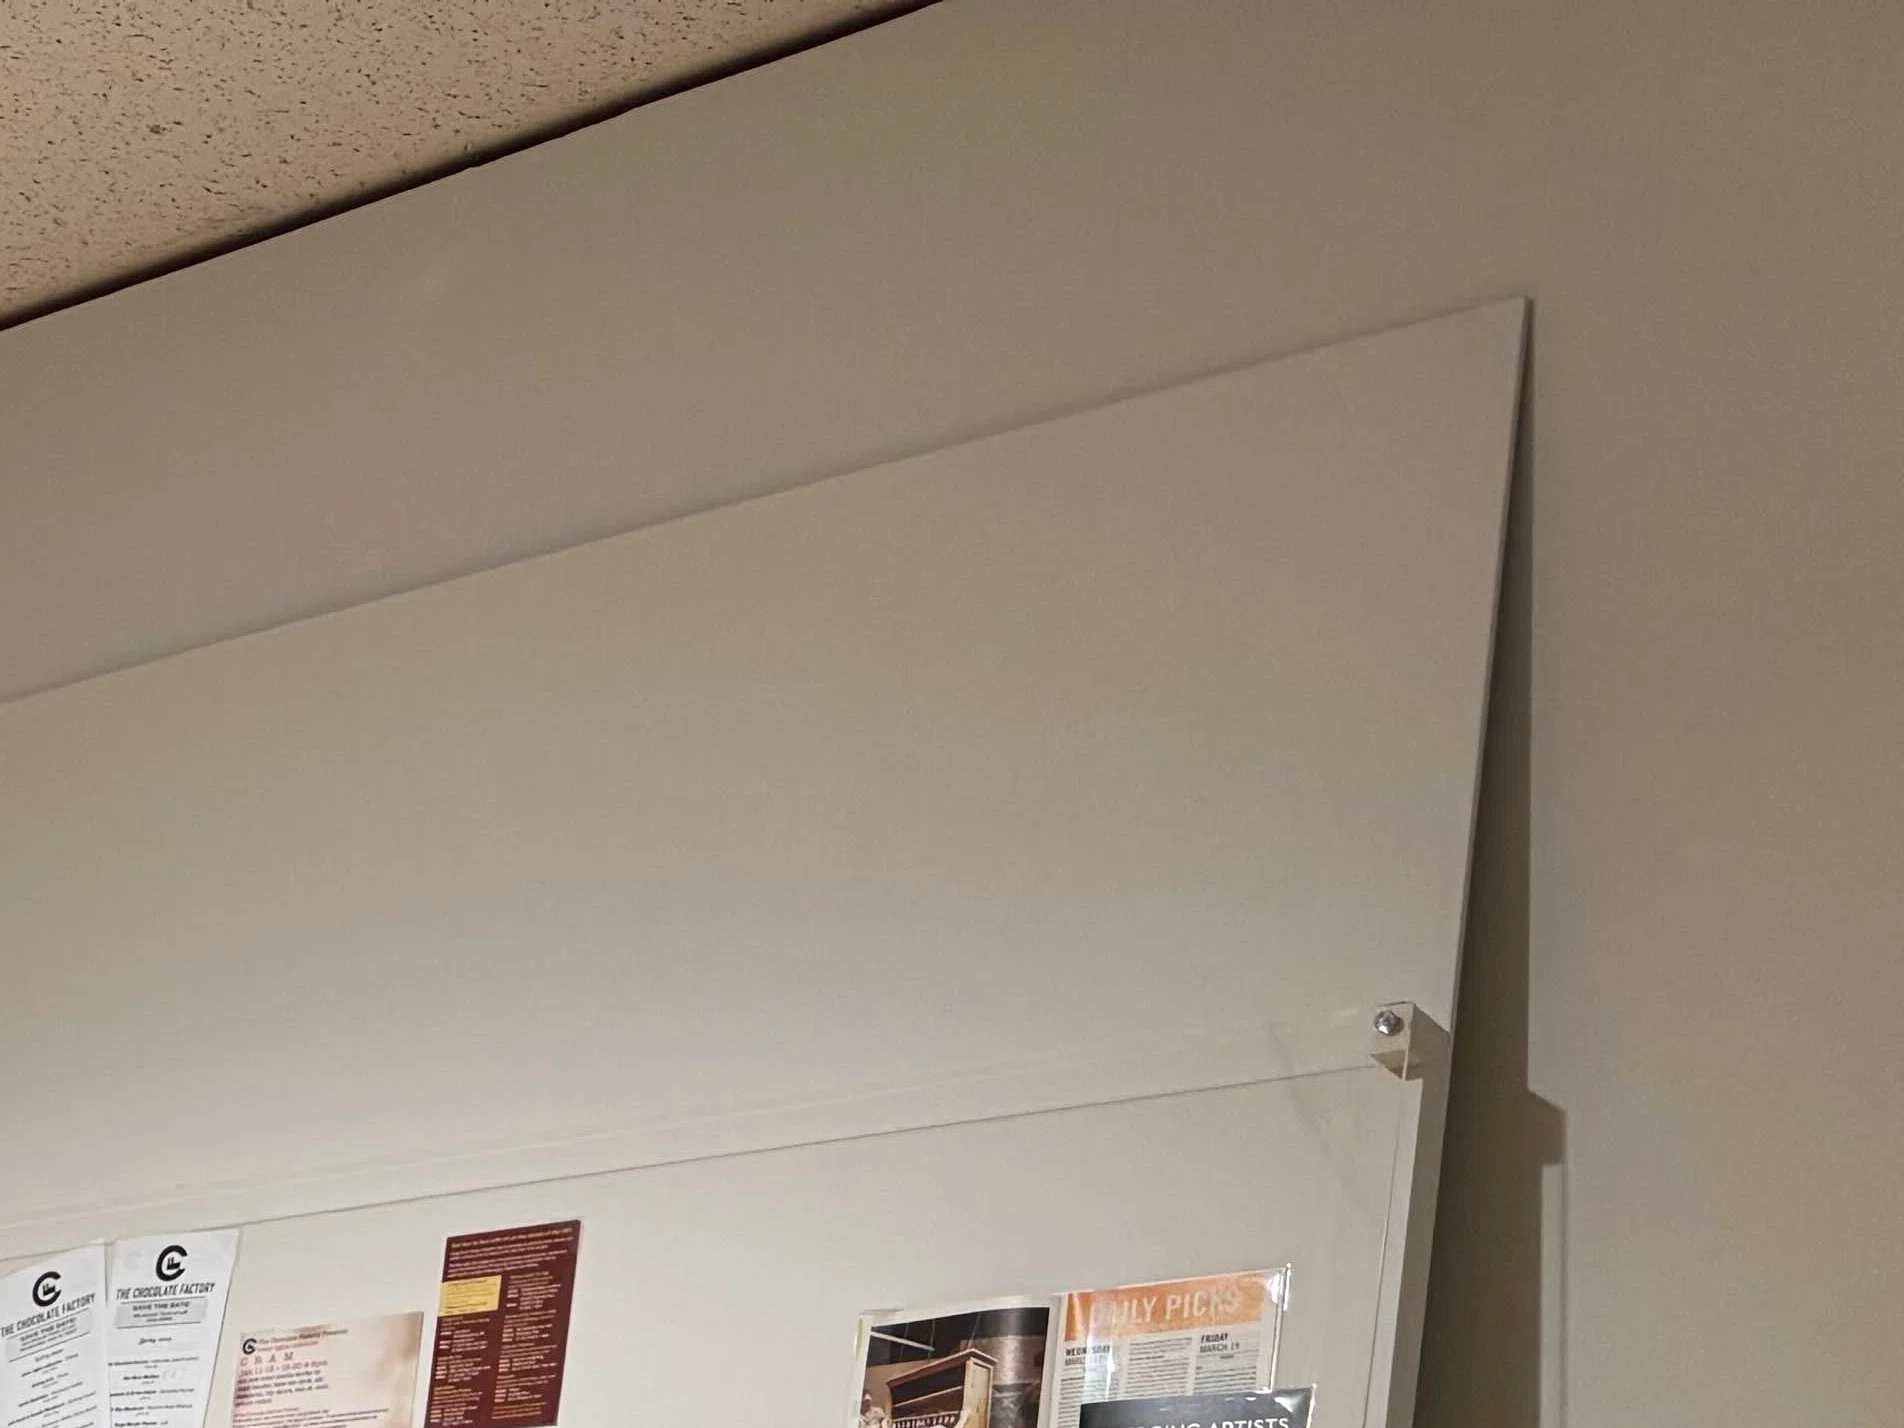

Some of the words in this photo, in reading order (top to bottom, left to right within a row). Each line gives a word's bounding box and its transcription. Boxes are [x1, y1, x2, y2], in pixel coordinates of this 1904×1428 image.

[116, 1289, 130, 1300] THE
[132, 1284, 178, 1299] CHOCOLATE
[179, 1282, 216, 1295] FACTORY
[0, 1324, 15, 1338] THE
[16, 1309, 61, 1334] CHOCOLATE
[61, 1293, 95, 1318] FACTORY
[1200, 1332, 1229, 1344] FRIDAY
